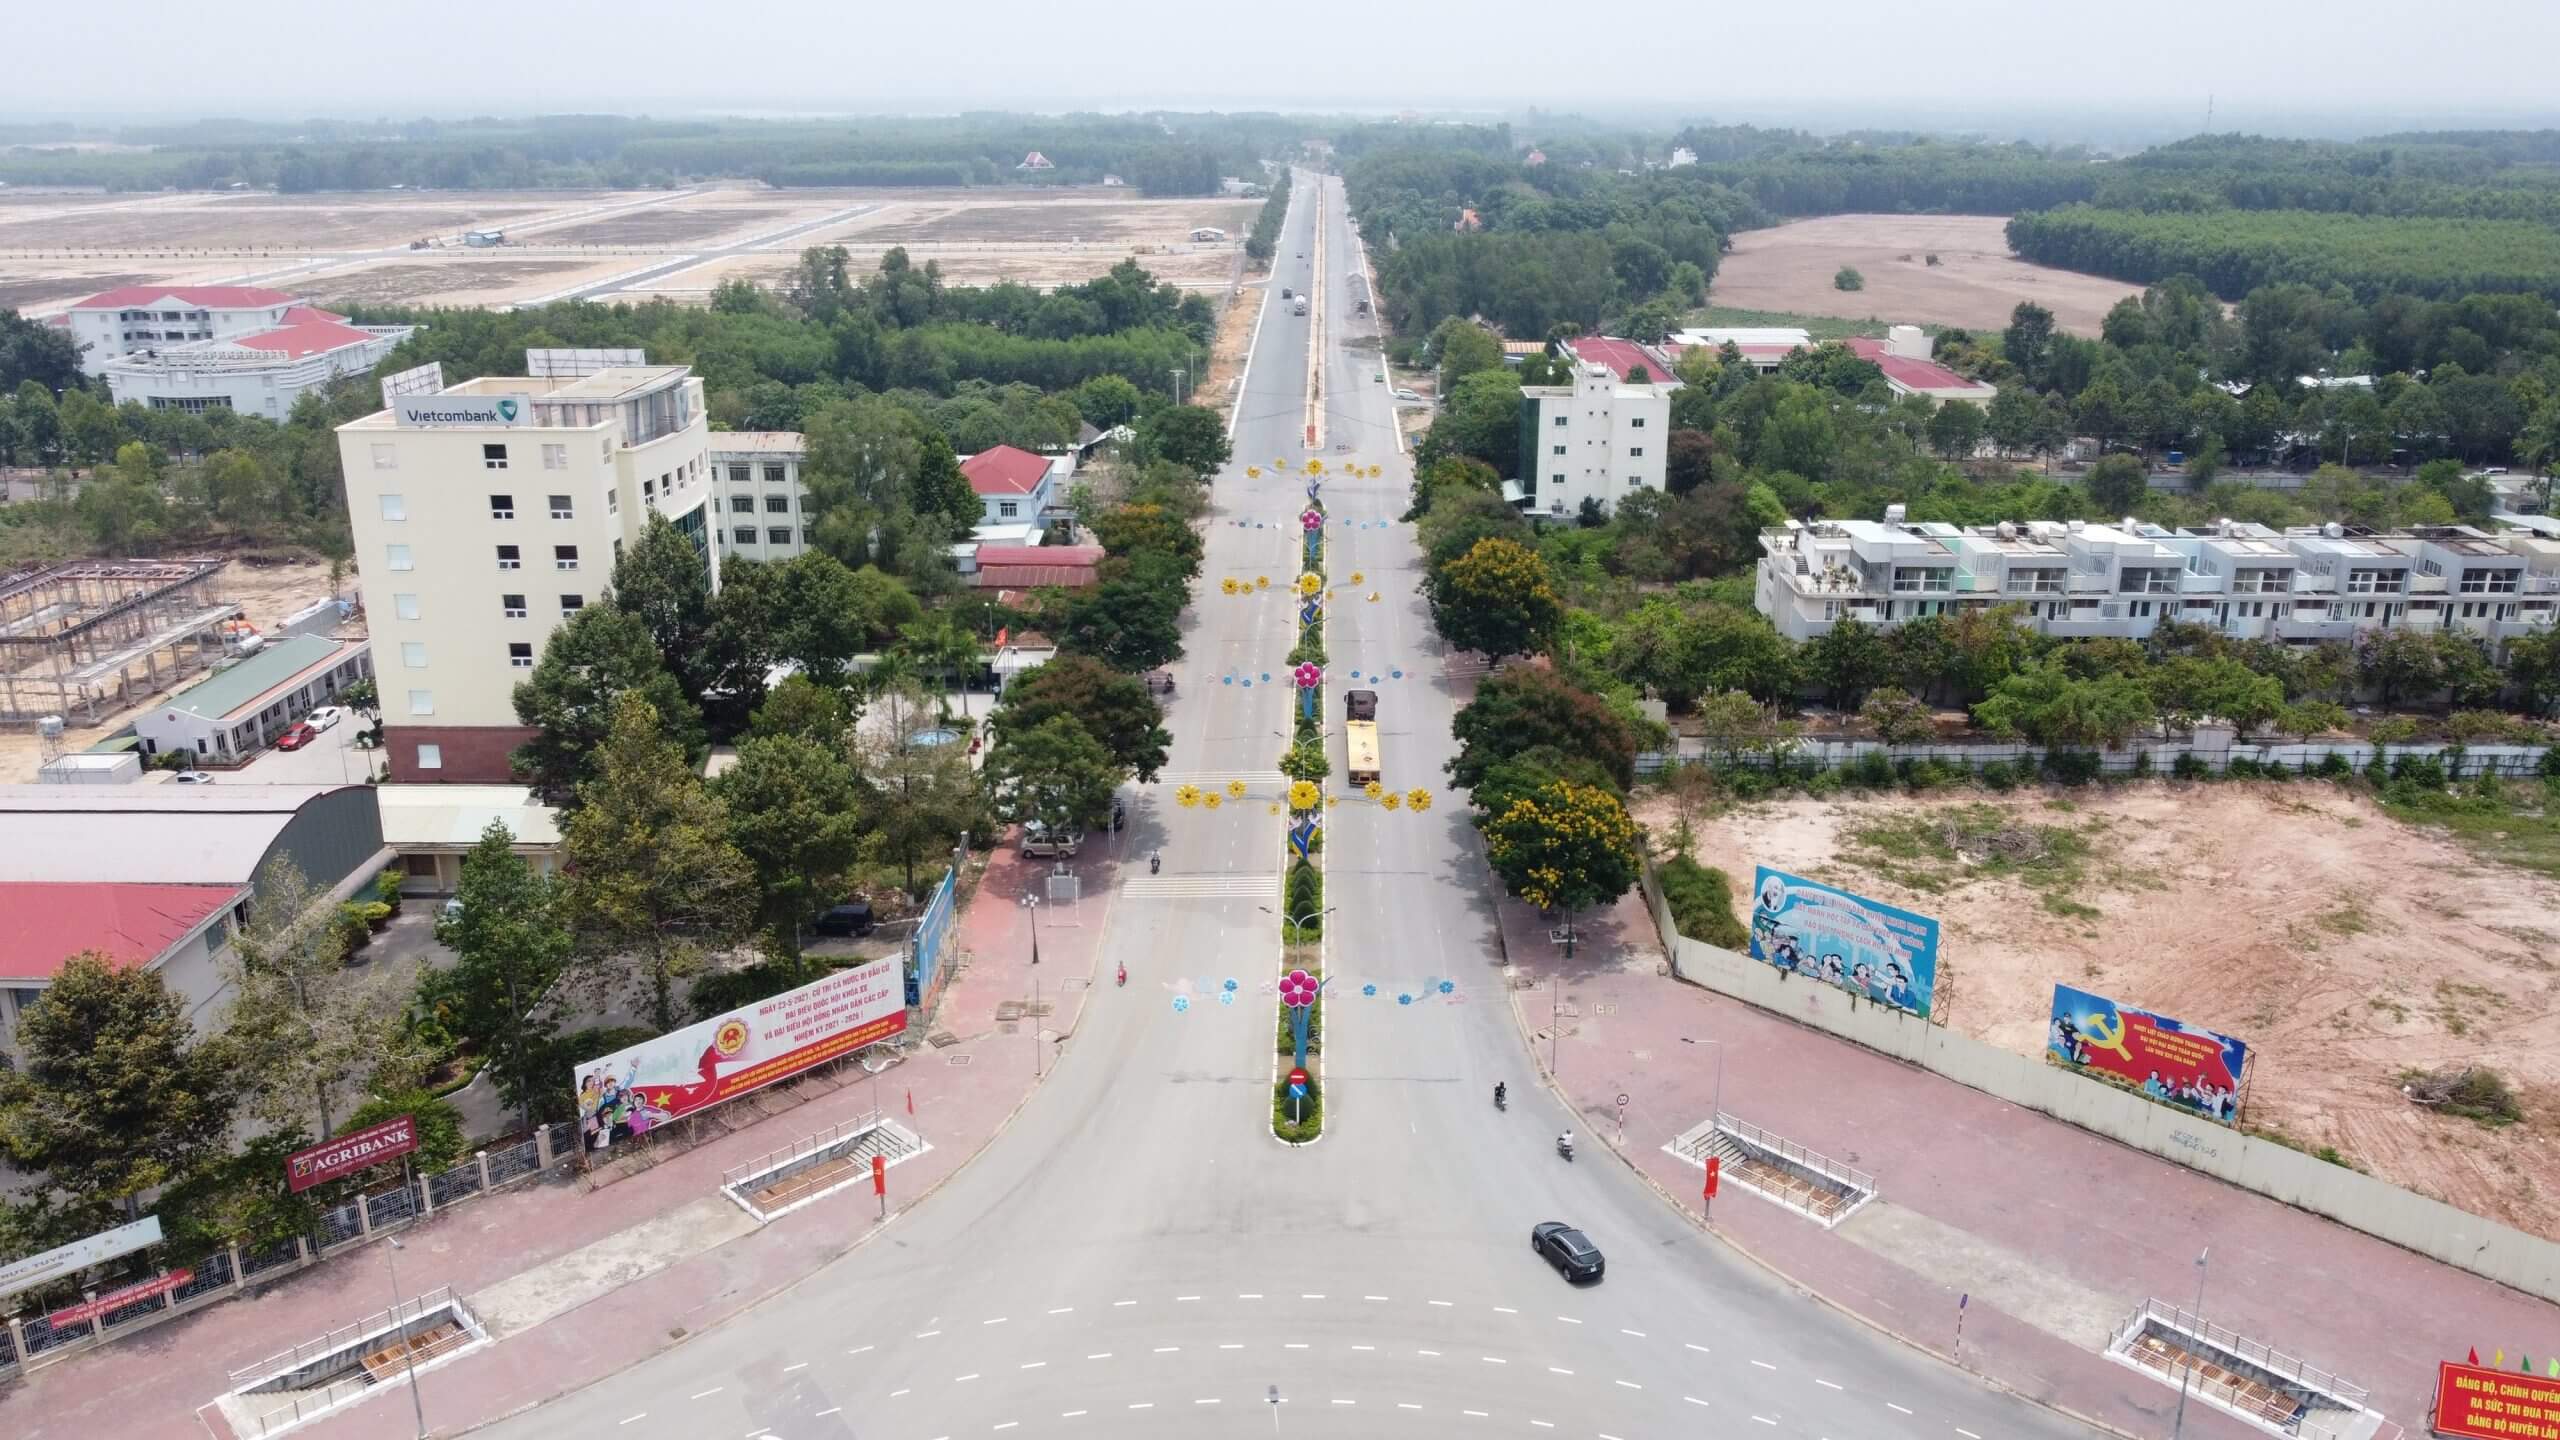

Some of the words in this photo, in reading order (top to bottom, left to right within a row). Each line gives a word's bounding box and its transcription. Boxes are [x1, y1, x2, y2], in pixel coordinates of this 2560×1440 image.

[407, 409, 498, 422] Vietcombank
[759, 1004, 777, 1016] NGÀY
[822, 985, 832, 997] TRI
[764, 1029, 773, 1041] VÀ
[832, 1004, 849, 1020] NHÂN
[864, 994, 877, 1007] CÁC
[825, 1019, 839, 1032] 2021
[314, 1128, 411, 1172] AGRIBANK
[2456, 1376, 2480, 1391] ĐẢNG
[2482, 1380, 2498, 1396] BỘ,
[2500, 1384, 2529, 1399] CHÍNH
[2470, 1397, 2483, 1409] RA
[2485, 1398, 2504, 1412] SỨC
[2505, 1403, 2520, 1416] THI
[2522, 1406, 2541, 1419] ĐUA
[2467, 1414, 2492, 1428] ĐẢNG
[2494, 1420, 2507, 1433] BỘ
[2509, 1421, 2539, 1436] HUYỆN
[2541, 1424, 2558, 1440] LẦN
